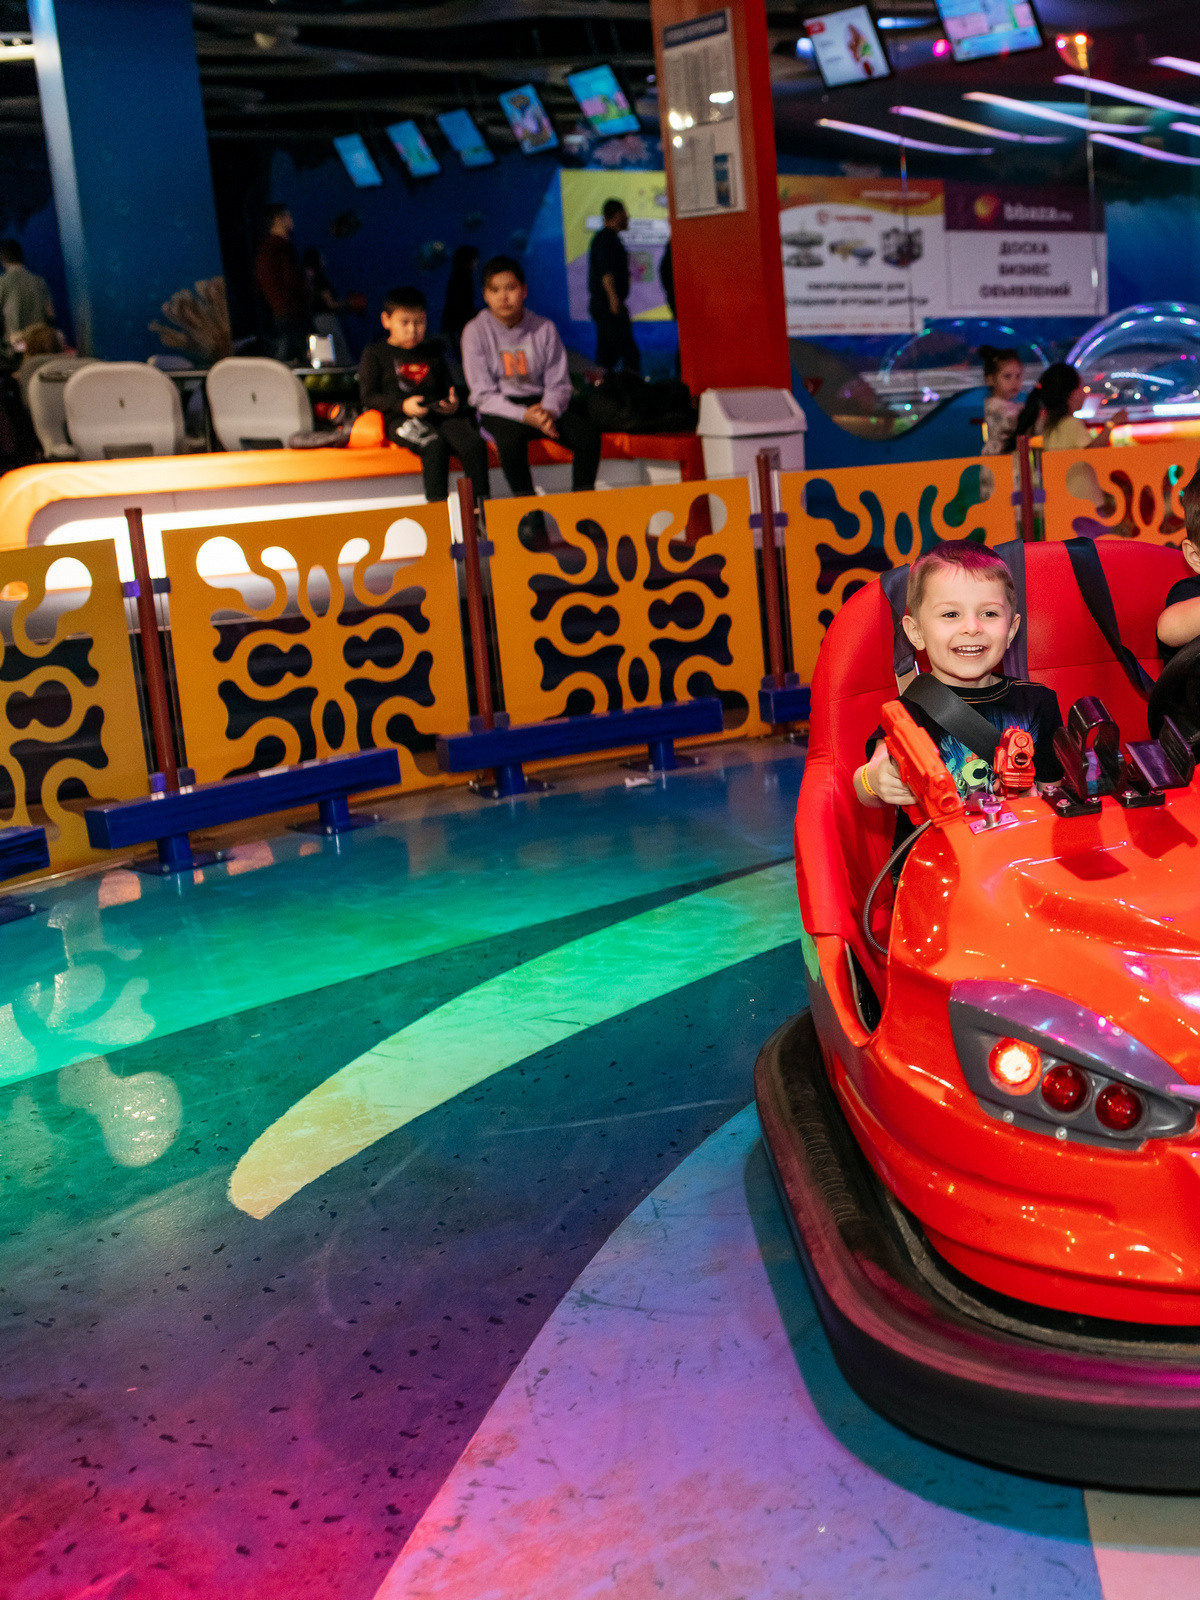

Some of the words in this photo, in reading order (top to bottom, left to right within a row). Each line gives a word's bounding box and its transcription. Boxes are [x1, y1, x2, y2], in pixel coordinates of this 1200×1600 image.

[1000, 240, 1049, 256] ДОСКА
[999, 263, 1051, 277] БИЗНЕС
[979, 281, 1072, 298] ОБЪЯВЛЕНИЙ
[502, 350, 527, 377] N
